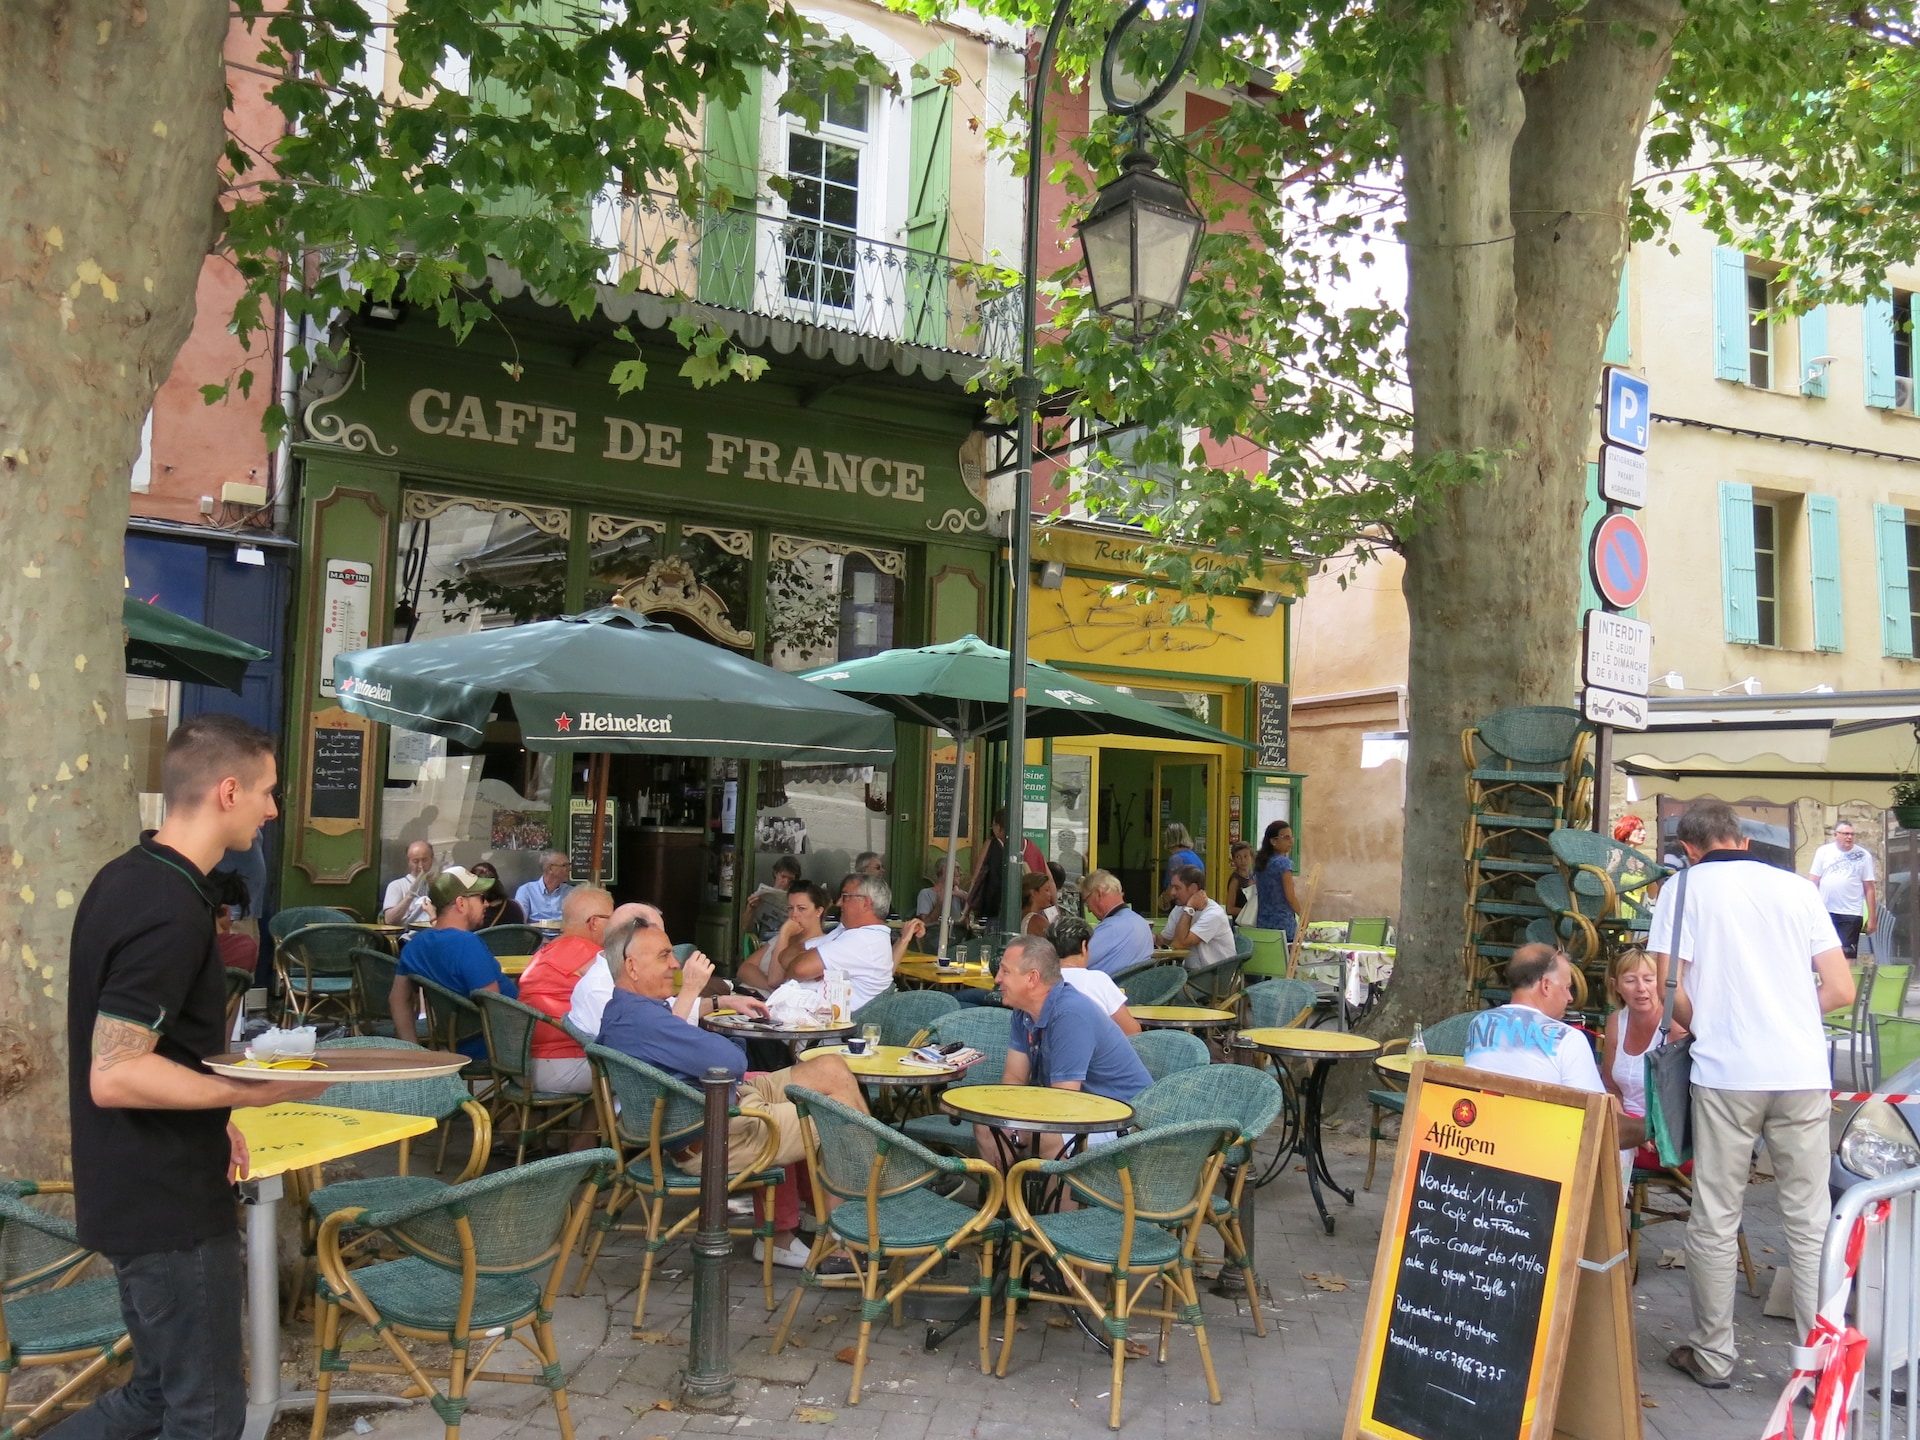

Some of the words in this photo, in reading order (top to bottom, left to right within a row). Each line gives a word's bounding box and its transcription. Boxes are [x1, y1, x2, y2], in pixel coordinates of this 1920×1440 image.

[1619, 385, 1638, 429] P
[409, 388, 576, 453] CAFE
[603, 416, 682, 468] DE
[706, 432, 925, 502] FRANCE
[1608, 452, 1645, 470] STATIONNEMENT
[1617, 470, 1635, 481] PAYANT
[1611, 484, 1641, 498] HORODATEUR
[330, 571, 369, 582] MARTINI
[1598, 619, 1643, 643] INTERDIT
[1605, 640, 1613, 651] LE
[1616, 643, 1635, 656] JEUDI
[1591, 651, 1600, 662] ET
[1603, 654, 1611, 665] LE
[1613, 657, 1647, 673] DIMANCHE
[1596, 667, 1605, 678] DE
[579, 712, 672, 733] Heineken
[1424, 1121, 1495, 1156] Affligem
[1420, 1153, 1472, 1201] Vendredi
[1418, 1199, 1436, 1211] au
[1441, 1201, 1471, 1232] Café
[1472, 1213, 1490, 1230] de
[1489, 1217, 1532, 1239] France
[1405, 1253, 1425, 1270] avec
[1429, 1258, 1438, 1275] le
[1396, 1294, 1442, 1322] Restauration
[1444, 1311, 1452, 1325] et
